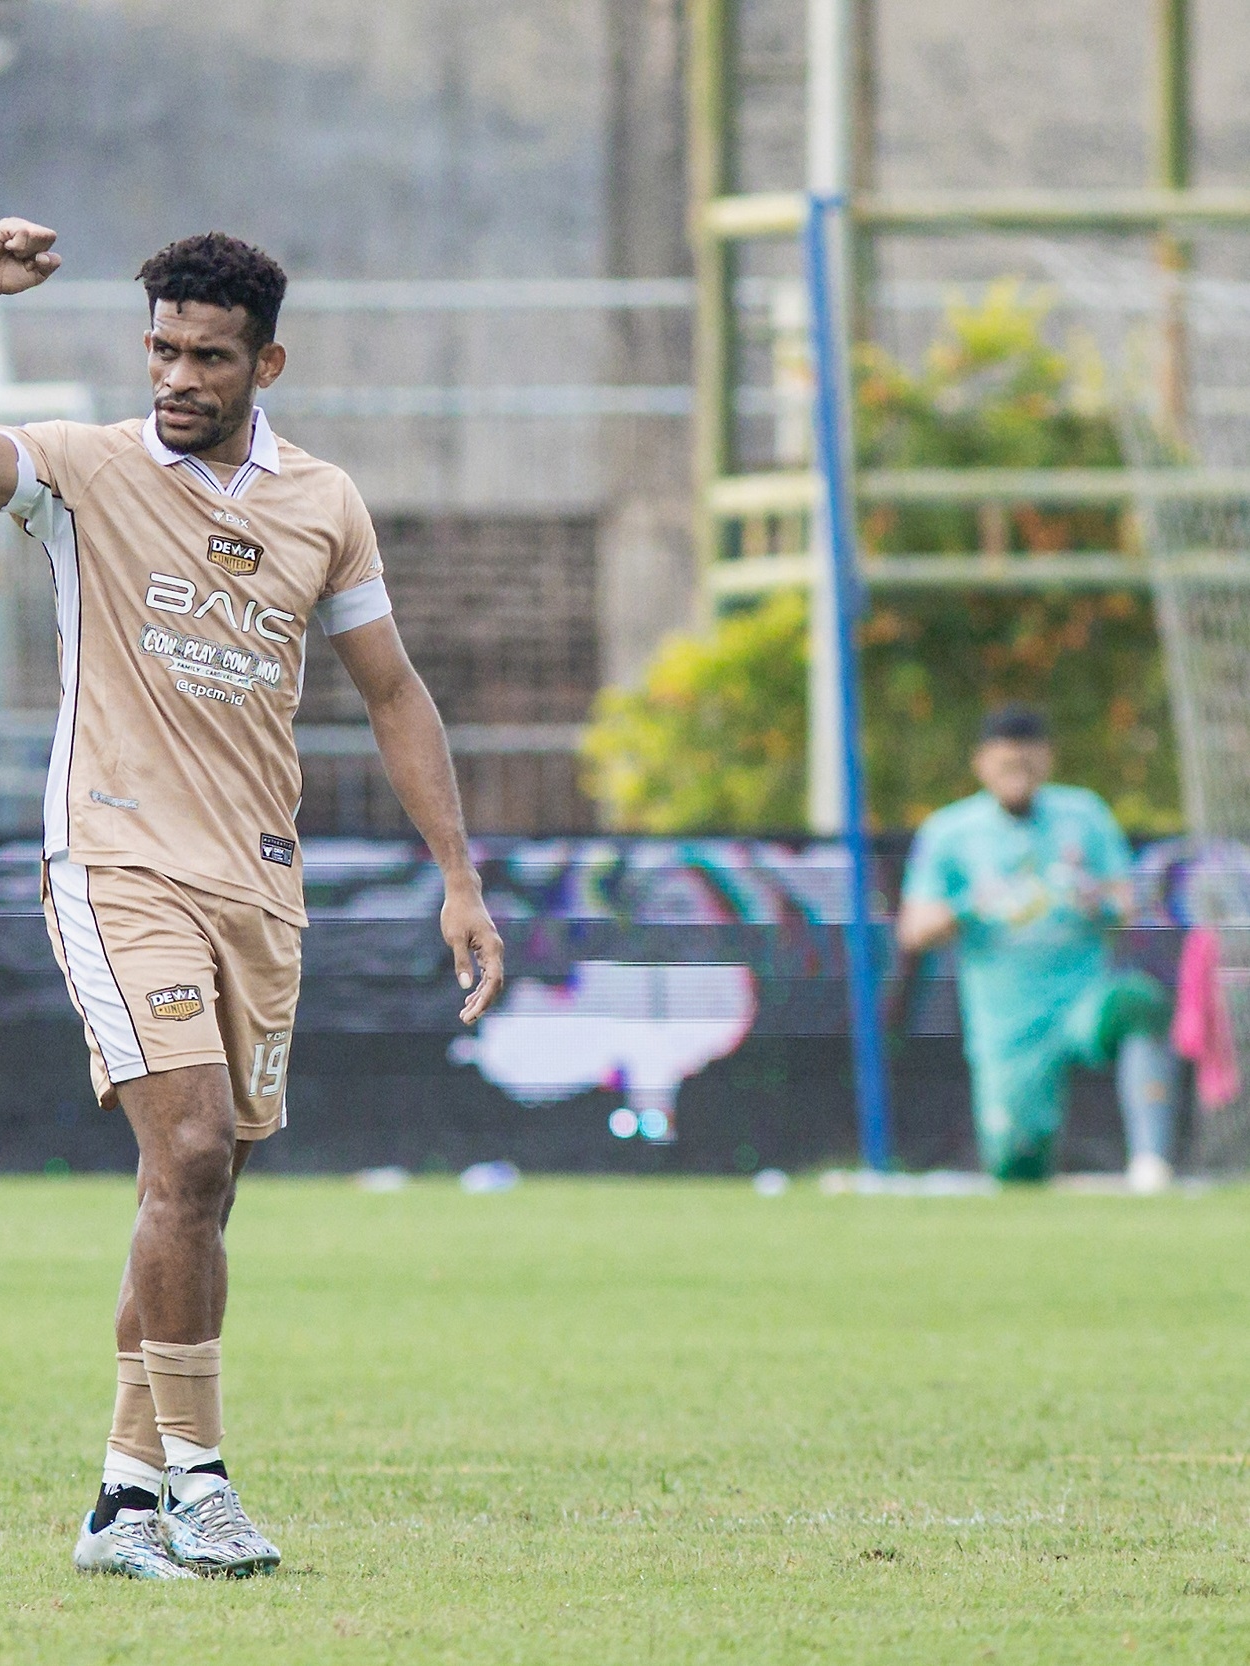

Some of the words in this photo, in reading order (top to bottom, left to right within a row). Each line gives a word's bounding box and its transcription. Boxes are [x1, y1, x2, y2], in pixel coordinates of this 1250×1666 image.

[212, 539, 256, 560] DEWA
[218, 554, 247, 570] UNITED
[145, 571, 295, 643] BAIC
[143, 628, 178, 655] COW
[183, 640, 216, 664] PLAY
[222, 650, 252, 673] COW
[255, 660, 281, 685] MOO
[176, 679, 246, 706] @cpcm.id
[150, 988, 199, 1006] DEWA
[164, 1002, 195, 1014] UNITED
[248, 1042, 287, 1097] 19
